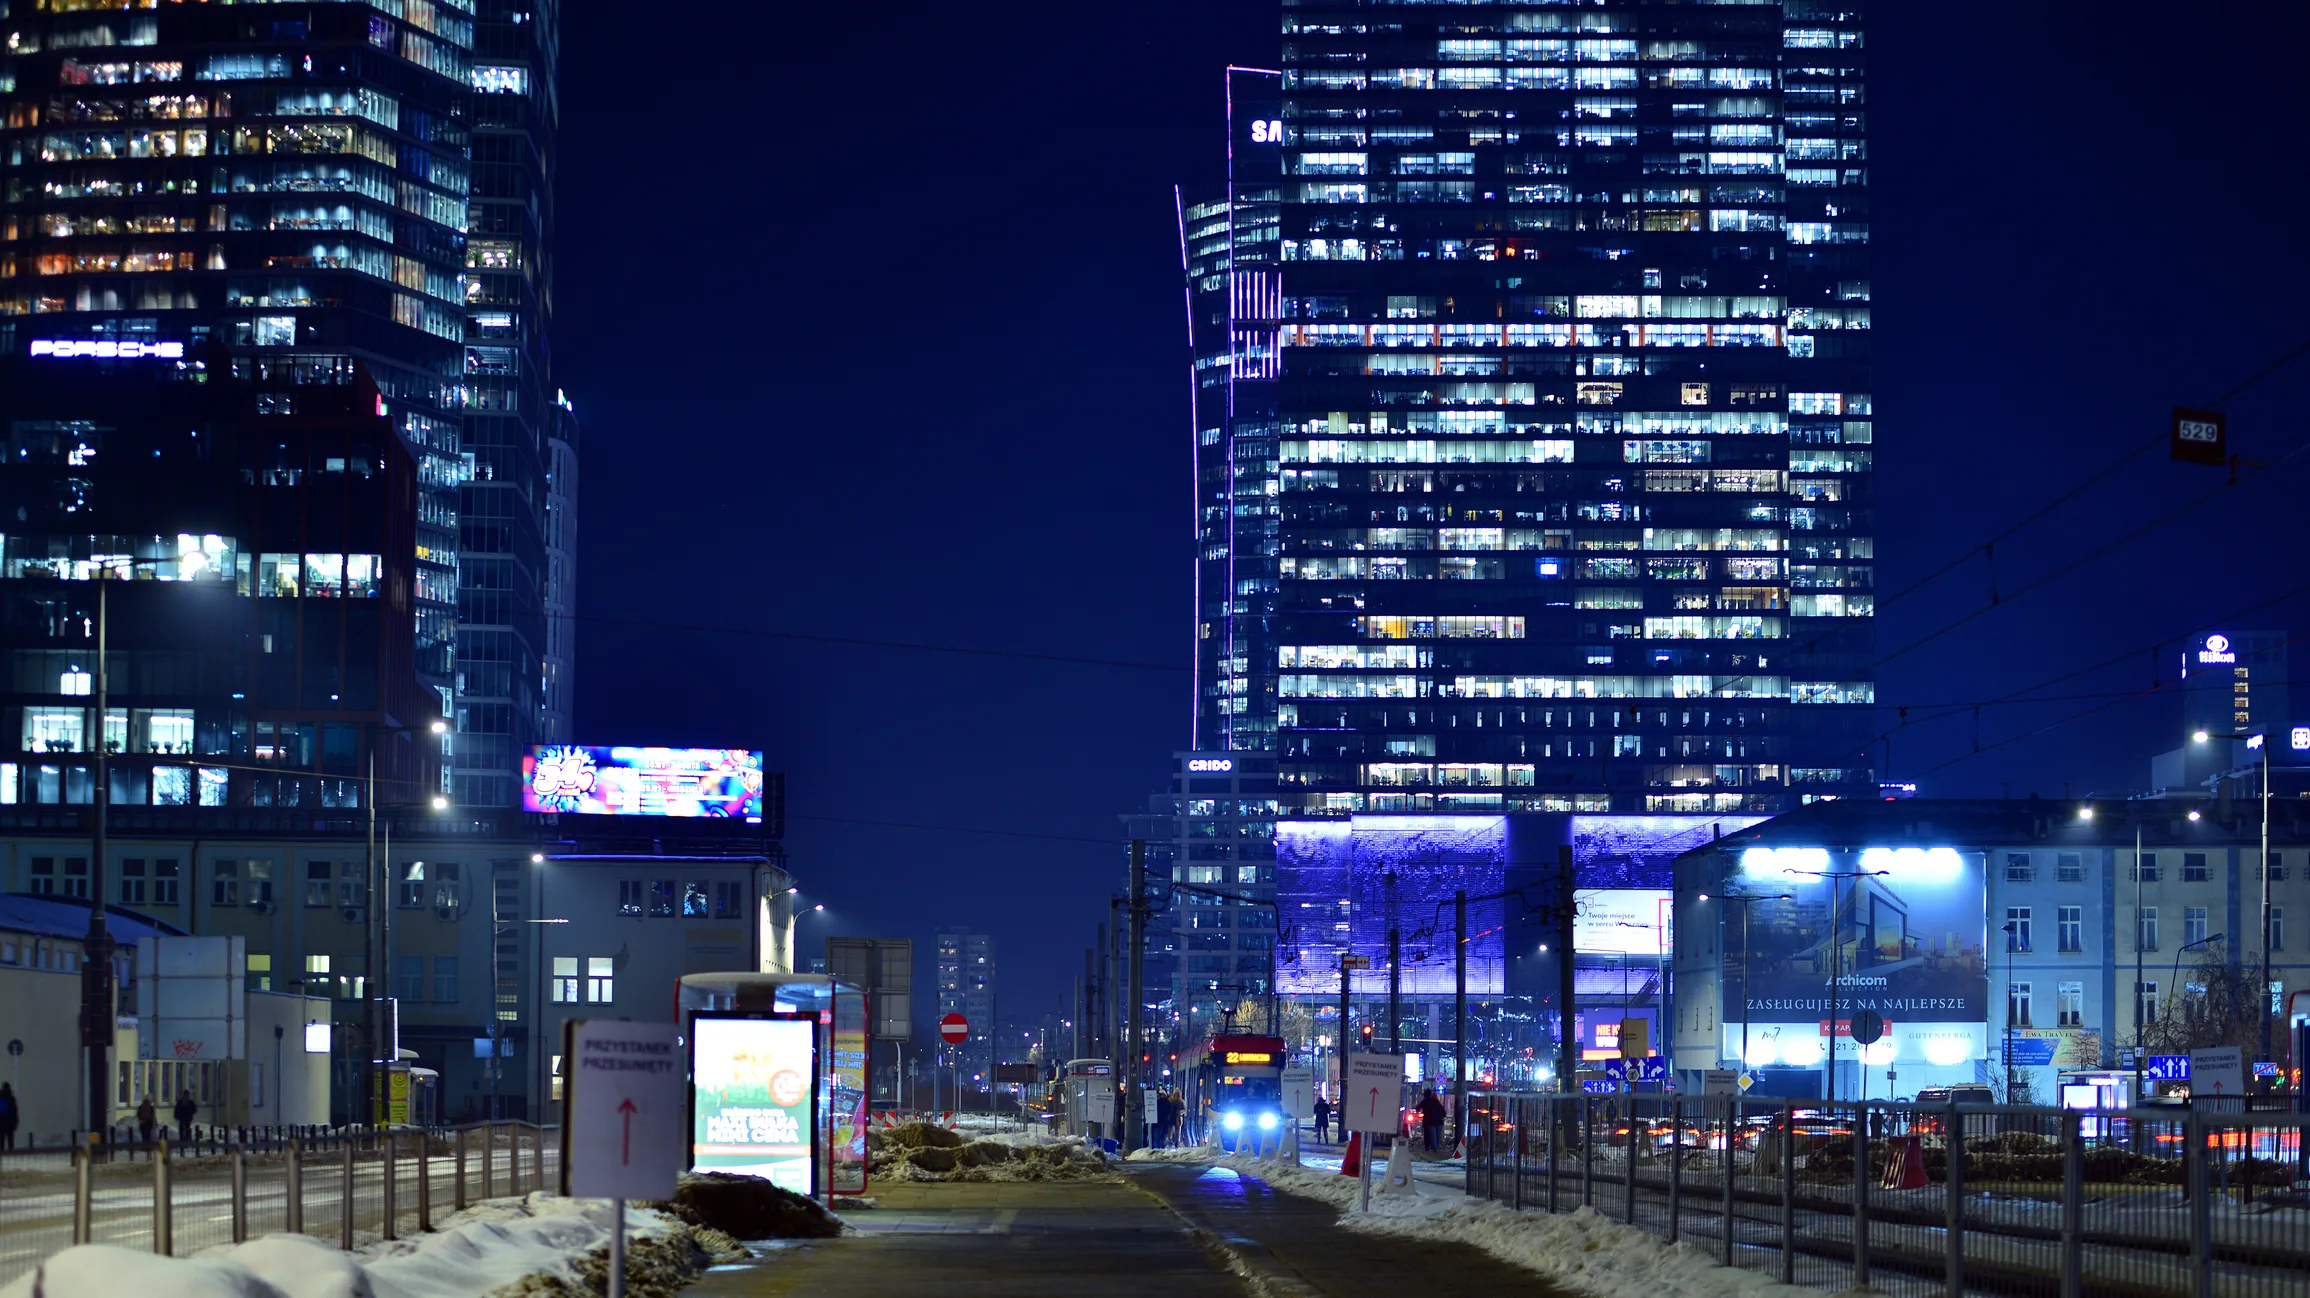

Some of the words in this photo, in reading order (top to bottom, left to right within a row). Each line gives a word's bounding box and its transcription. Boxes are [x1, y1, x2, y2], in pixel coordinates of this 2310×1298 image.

[31, 340, 183, 357] PORSCHE
[2182, 422, 2216, 440] 529
[1189, 760, 1232, 771] CRIDO
[1588, 912, 1608, 920] Twoje
[1610, 912, 1636, 920] miejsce
[1825, 974, 1887, 986] Archicom
[1747, 999, 1850, 1012] ZASŁUGUJESZ
[1857, 999, 1877, 1010] NA
[1884, 998, 1966, 1011] NAJLEPSZE
[1908, 1032, 1972, 1040] GUTENBERGA
[1226, 1052, 1239, 1063] 22
[2195, 1054, 2237, 1063] PRZYSTANEK
[1355, 1060, 1399, 1070] PRZYSTANEK
[2194, 1063, 2238, 1071] PRZESUNIĘTY
[2255, 1064, 2277, 1074] TAXI
[1353, 1068, 1399, 1079] PRZESUNIĘTY
